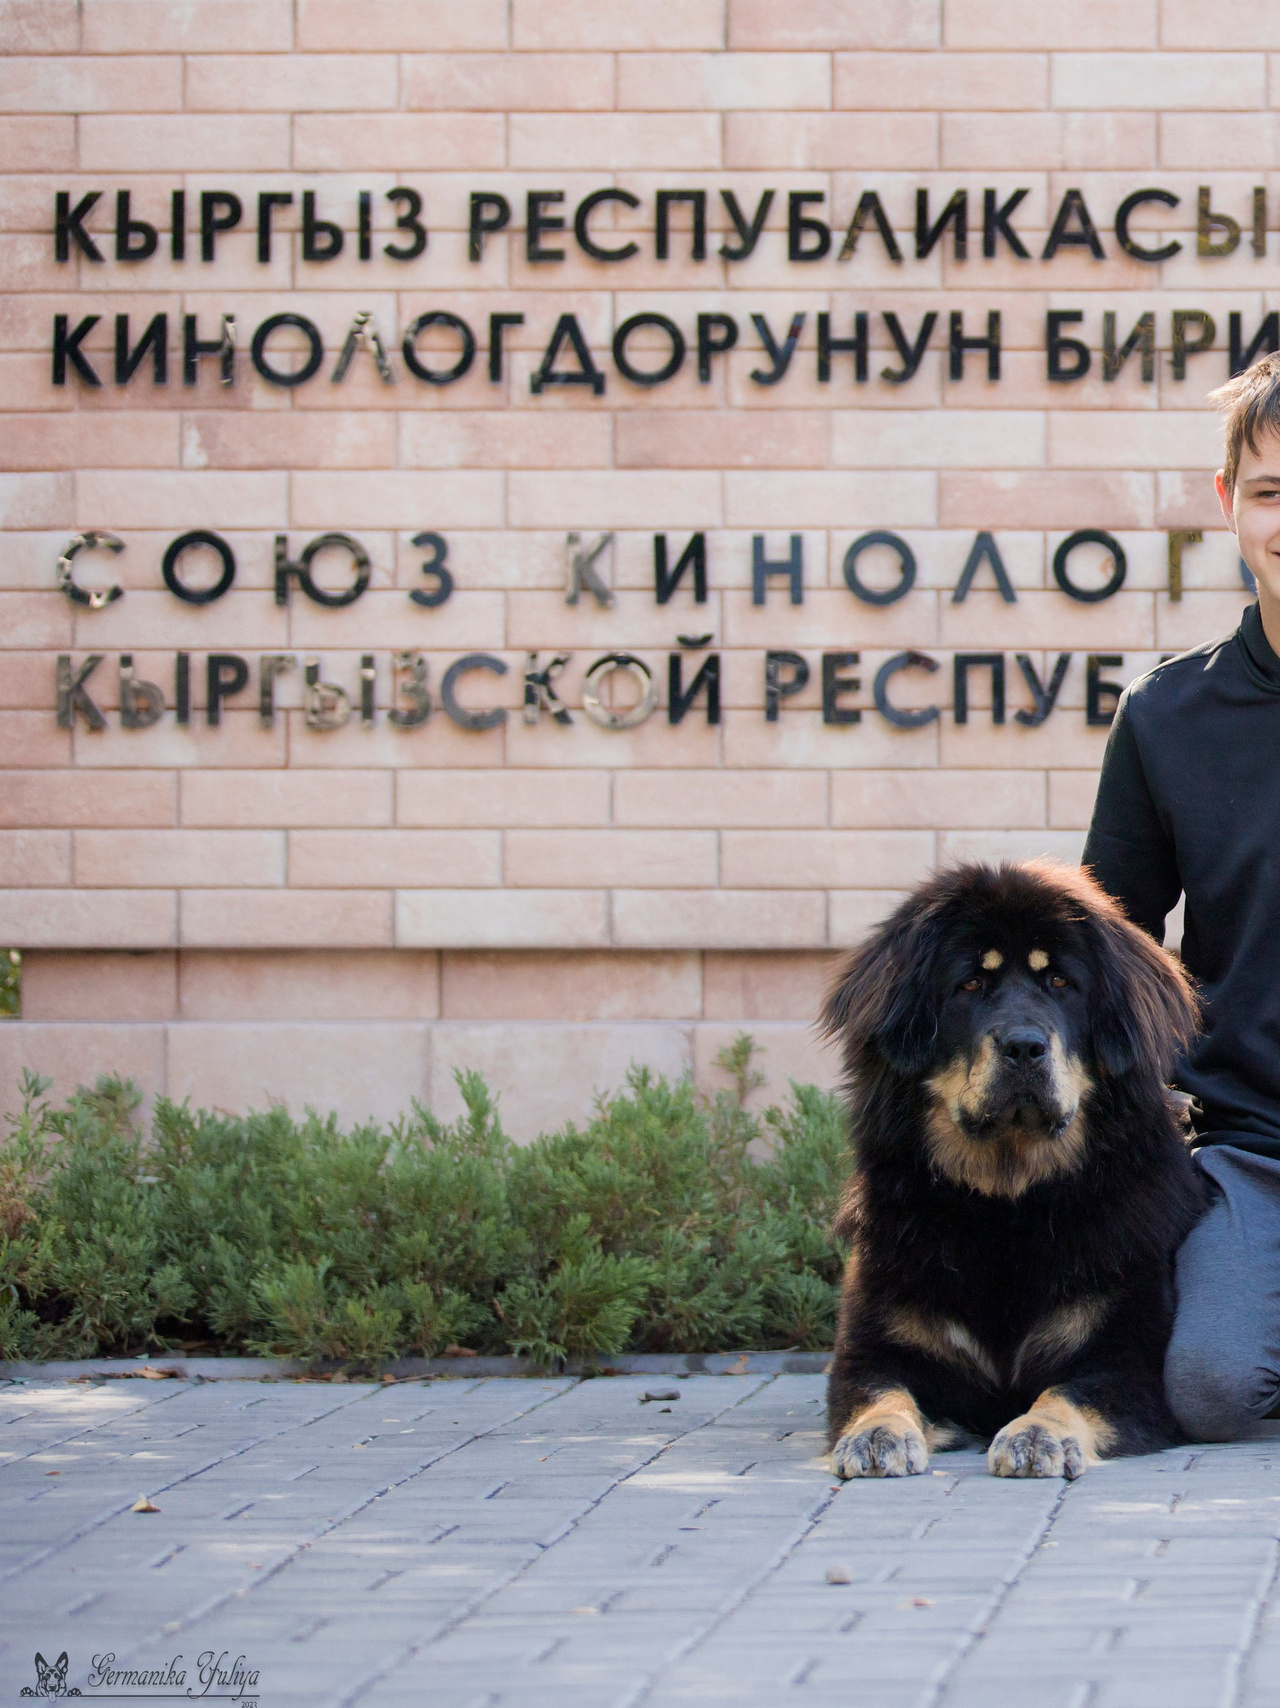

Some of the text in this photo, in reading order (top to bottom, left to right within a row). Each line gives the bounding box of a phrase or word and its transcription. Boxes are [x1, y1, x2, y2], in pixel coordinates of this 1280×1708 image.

[54, 187, 429, 263] КЫРГЫЗ
[51, 310, 1001, 395] КИНОЛОГДОРУНУН
[57, 529, 454, 608] СОЮЗ
[56, 633, 1176, 732] КЫРГЫЗСКОЙ РЕСПУБ
